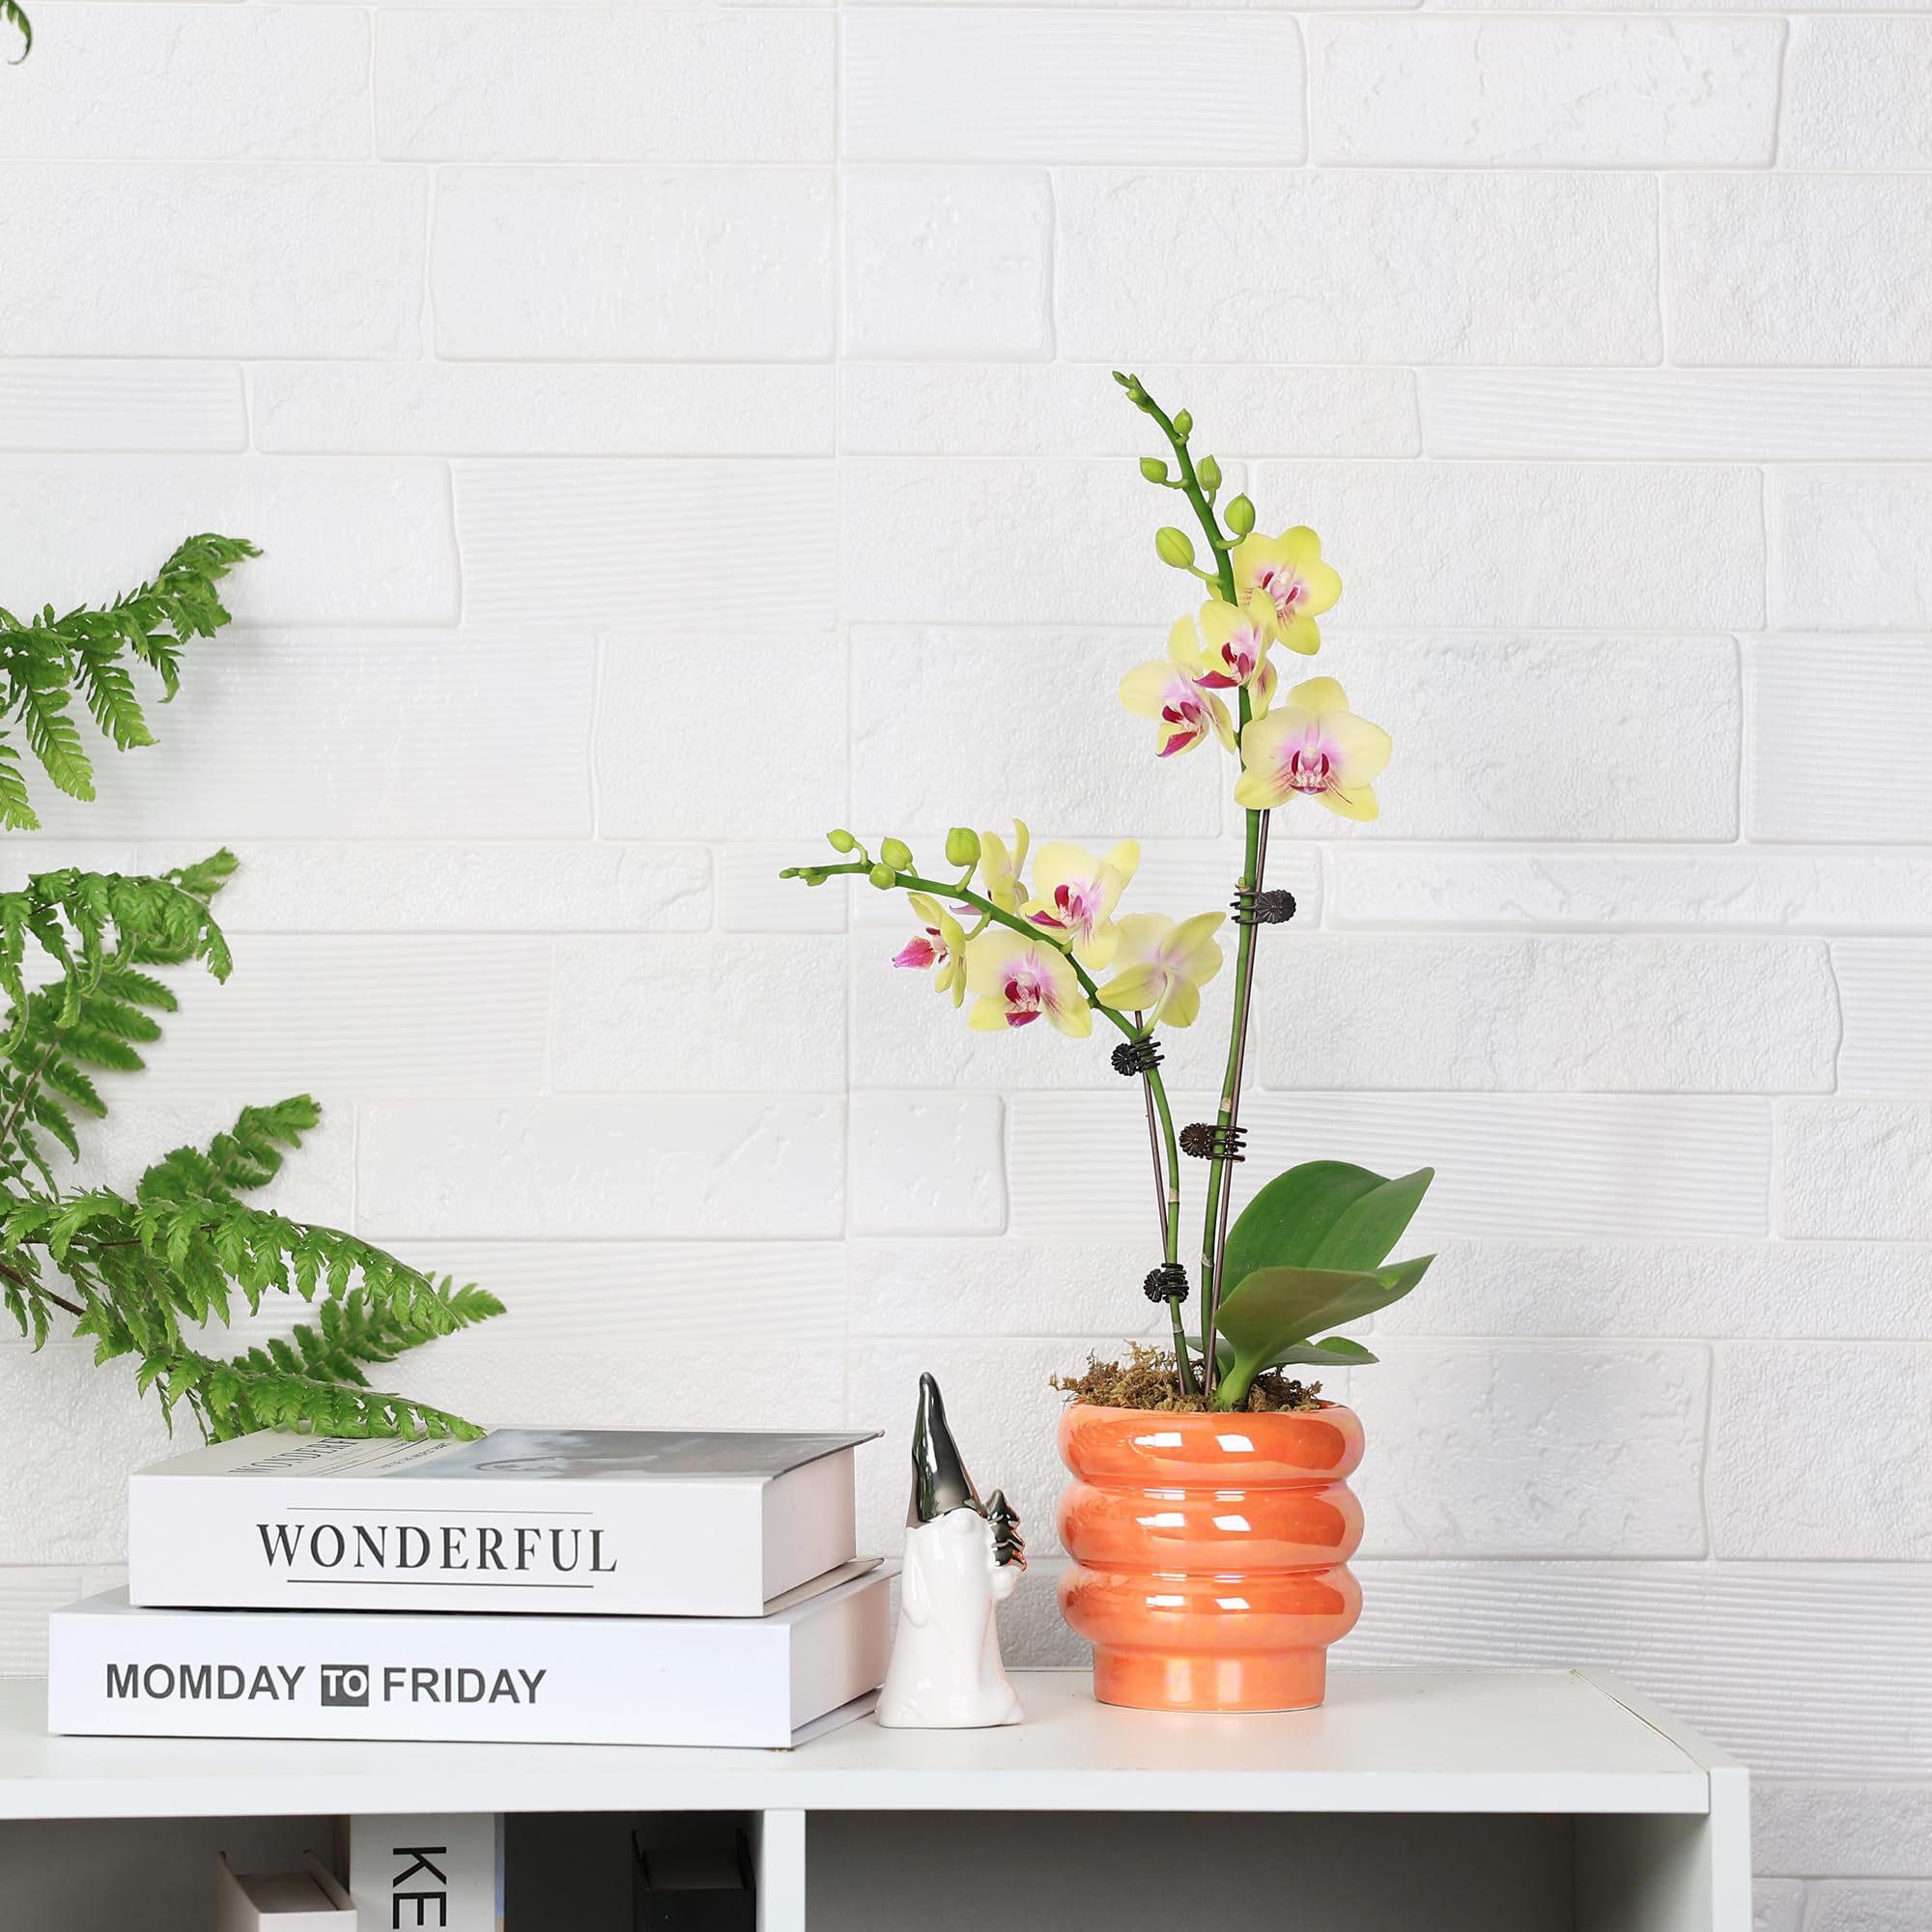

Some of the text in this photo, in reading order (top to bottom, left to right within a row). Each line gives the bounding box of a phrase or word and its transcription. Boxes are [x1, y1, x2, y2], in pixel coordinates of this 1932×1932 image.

[256, 1523, 617, 1573] WONDERFUL
[106, 1663, 547, 1704] MOMDAY TO FRIDAY
[392, 1846, 447, 1930] KE
